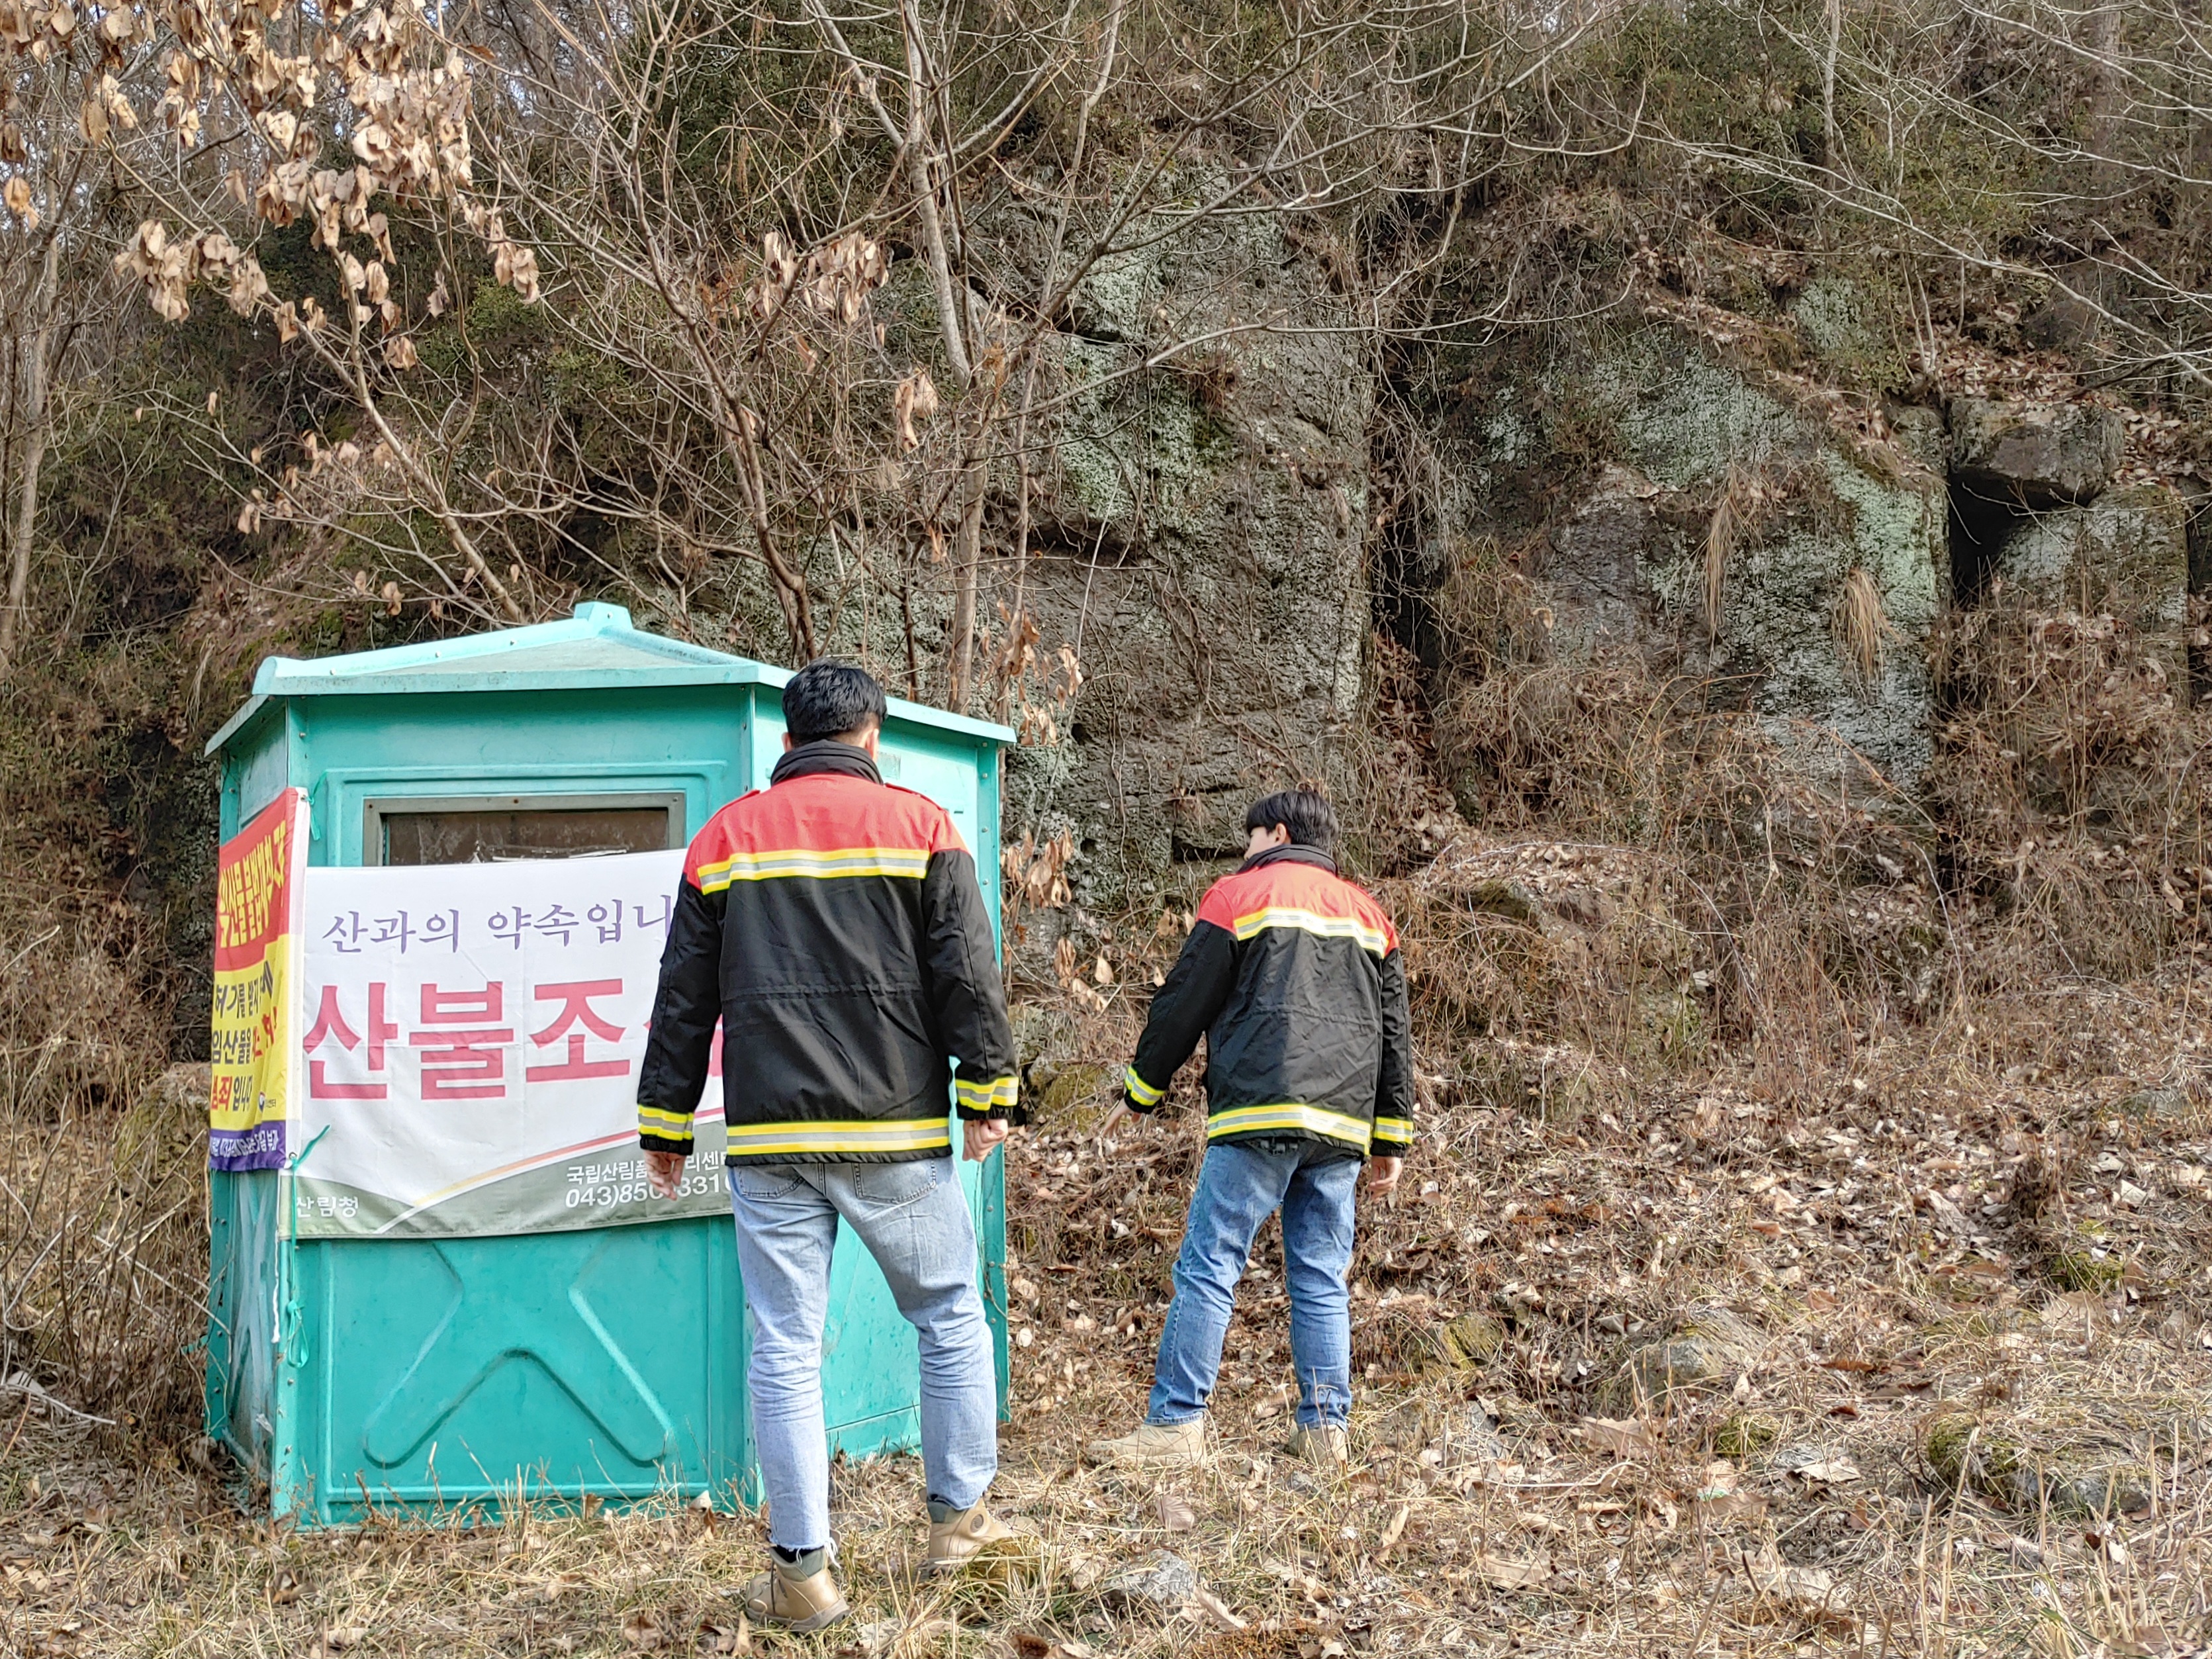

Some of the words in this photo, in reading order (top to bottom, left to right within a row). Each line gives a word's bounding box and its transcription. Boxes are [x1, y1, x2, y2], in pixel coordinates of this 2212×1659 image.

[322, 909, 459, 954] 산과의
[487, 894, 672, 950] 약속입니
[212, 1027, 252, 1065] 임산물을
[303, 978, 723, 1100] 산불조
[566, 1151, 728, 1185] 국립산림품리센
[296, 1196, 359, 1217] 산림청
